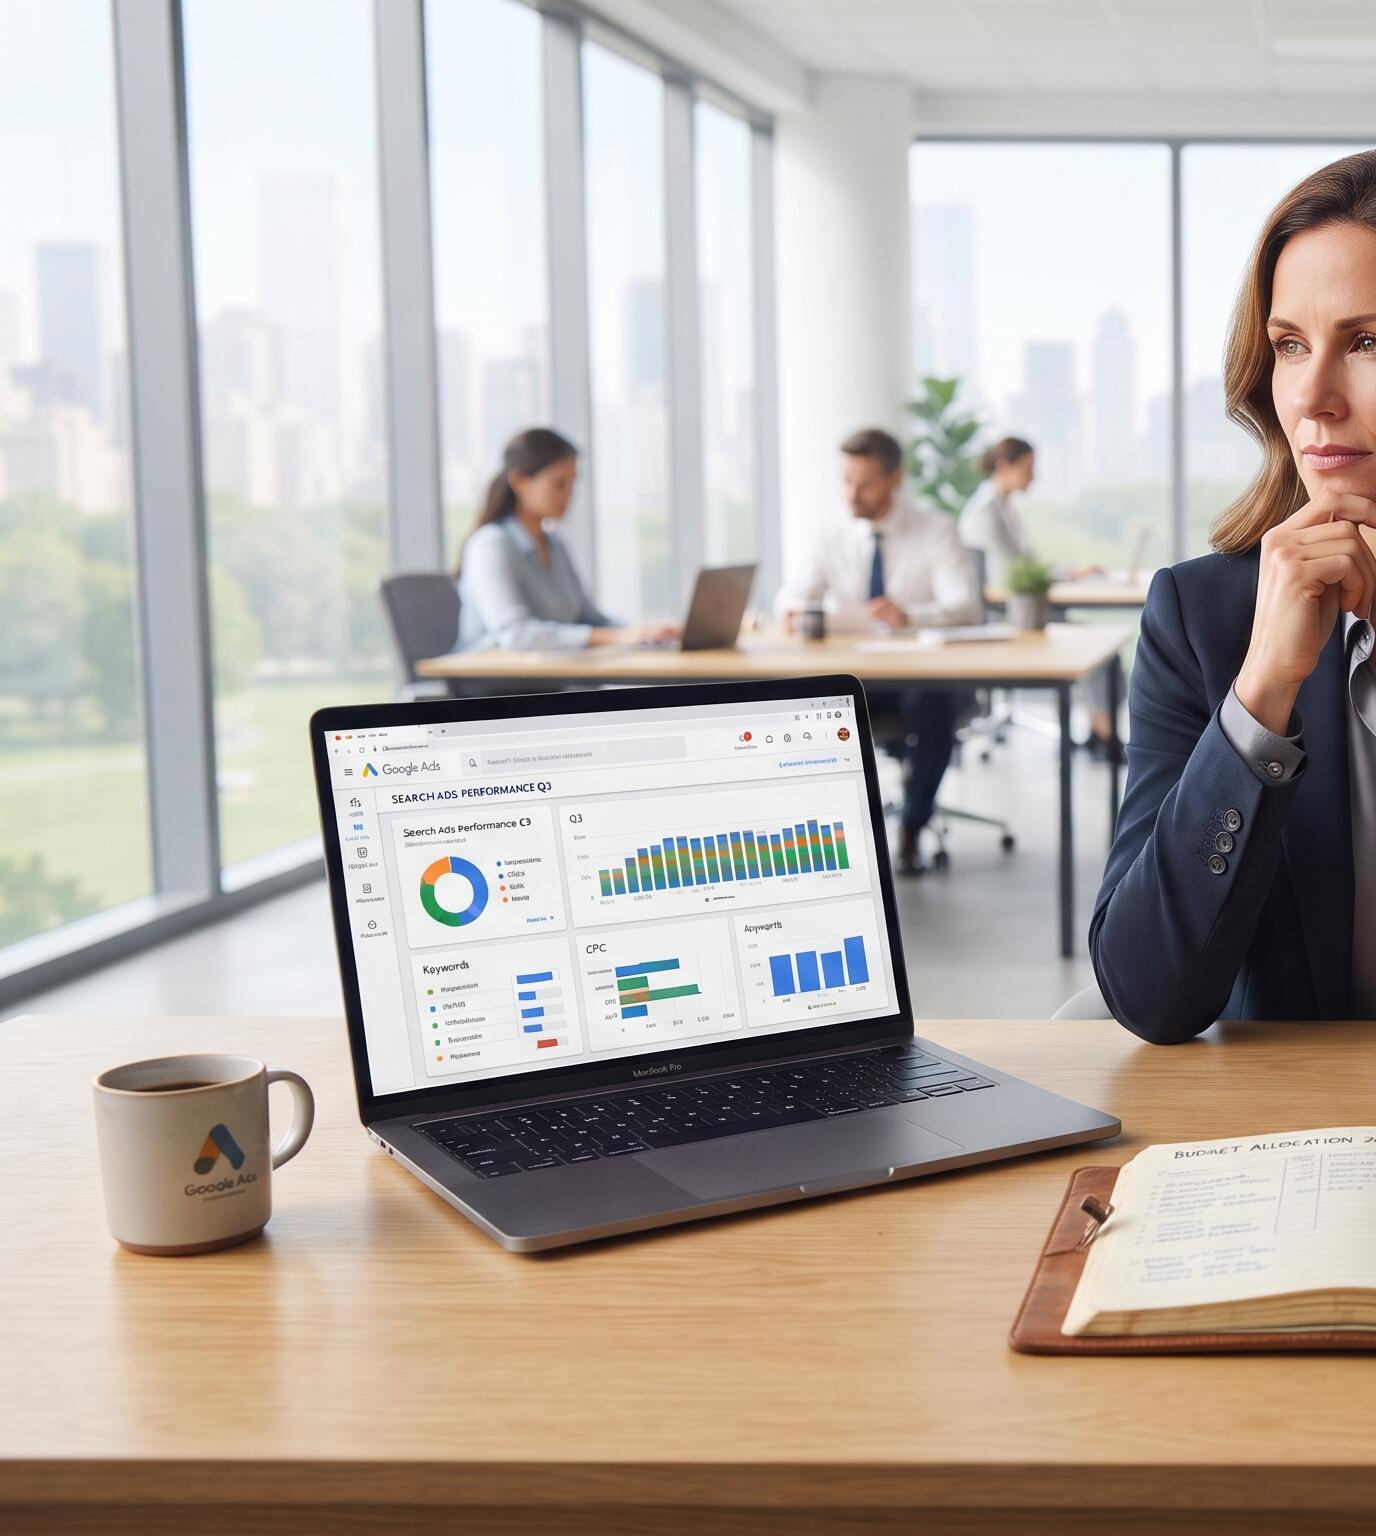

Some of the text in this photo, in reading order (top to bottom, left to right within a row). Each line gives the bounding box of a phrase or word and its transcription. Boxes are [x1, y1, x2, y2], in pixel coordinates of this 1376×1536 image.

[382, 761, 441, 777] Google Ads
[391, 781, 553, 805] SEARCH ADS PERFORMANCE Q3
[569, 813, 583, 824] Q3
[458, 819, 517, 834] Performance
[585, 943, 608, 955] CPC
[669, 1063, 682, 1071] Pro
[1250, 1136, 1354, 1152] ALLOCATION
